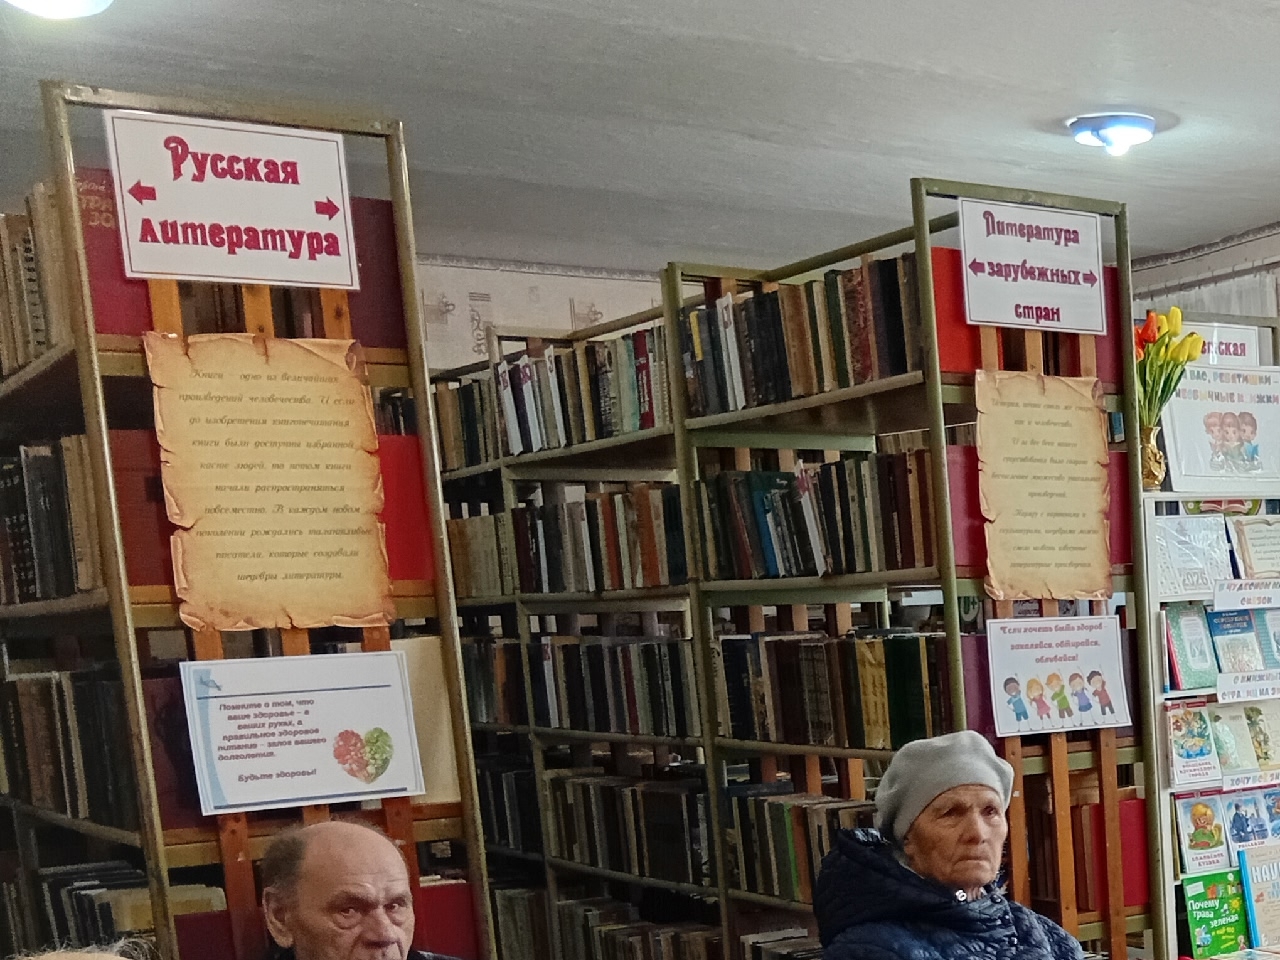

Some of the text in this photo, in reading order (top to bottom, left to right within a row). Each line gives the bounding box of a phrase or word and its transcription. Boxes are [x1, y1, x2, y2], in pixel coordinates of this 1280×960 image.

[164, 136, 300, 184] Русская
[983, 210, 1080, 247] Литература
[139, 218, 341, 260] Литература
[987, 259, 1082, 285] зарубежных
[1014, 303, 1061, 324] стран
[1000, 622, 1103, 635] Если хочешь быть здоров
[1221, 688, 1258, 700] СТРАИЦ
[219, 702, 262, 711] Помните
[253, 710, 295, 720] здоровье
[237, 722, 266, 730] ваших
[222, 728, 320, 742] правильное здоровое
[294, 738, 327, 746] вашего
[237, 768, 317, 783] Будьте здоровы!
[1188, 899, 1219, 910] Почему
[1193, 911, 1214, 921] трава
